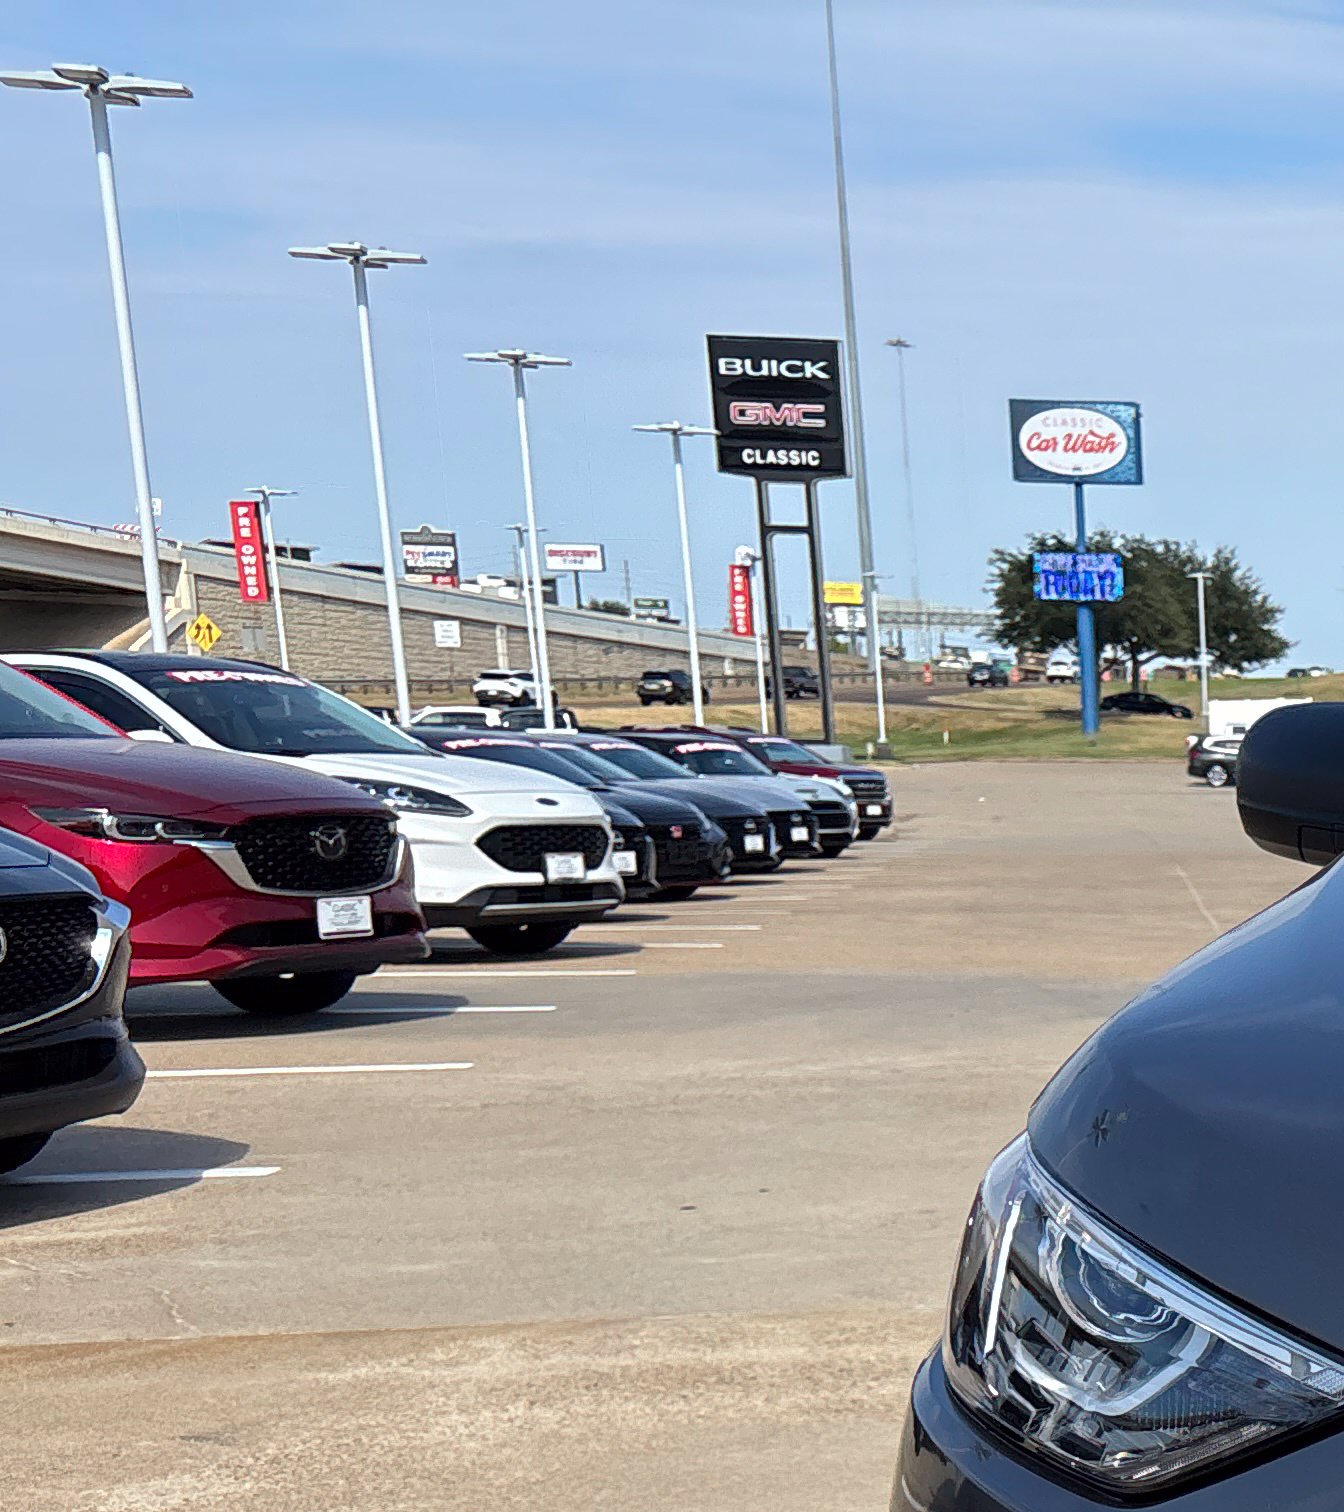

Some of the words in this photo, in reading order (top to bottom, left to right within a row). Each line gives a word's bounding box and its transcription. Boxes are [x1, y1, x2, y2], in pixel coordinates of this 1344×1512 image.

[718, 357, 831, 379] BUICK
[729, 401, 826, 428] GMC
[1041, 416, 1104, 428] CLASSIC
[1026, 431, 1058, 453] Car
[1063, 429, 1121, 454] Wash
[741, 449, 820, 467] CLASSIC
[237, 506, 252, 537] PRE
[241, 545, 259, 597] OWNED
